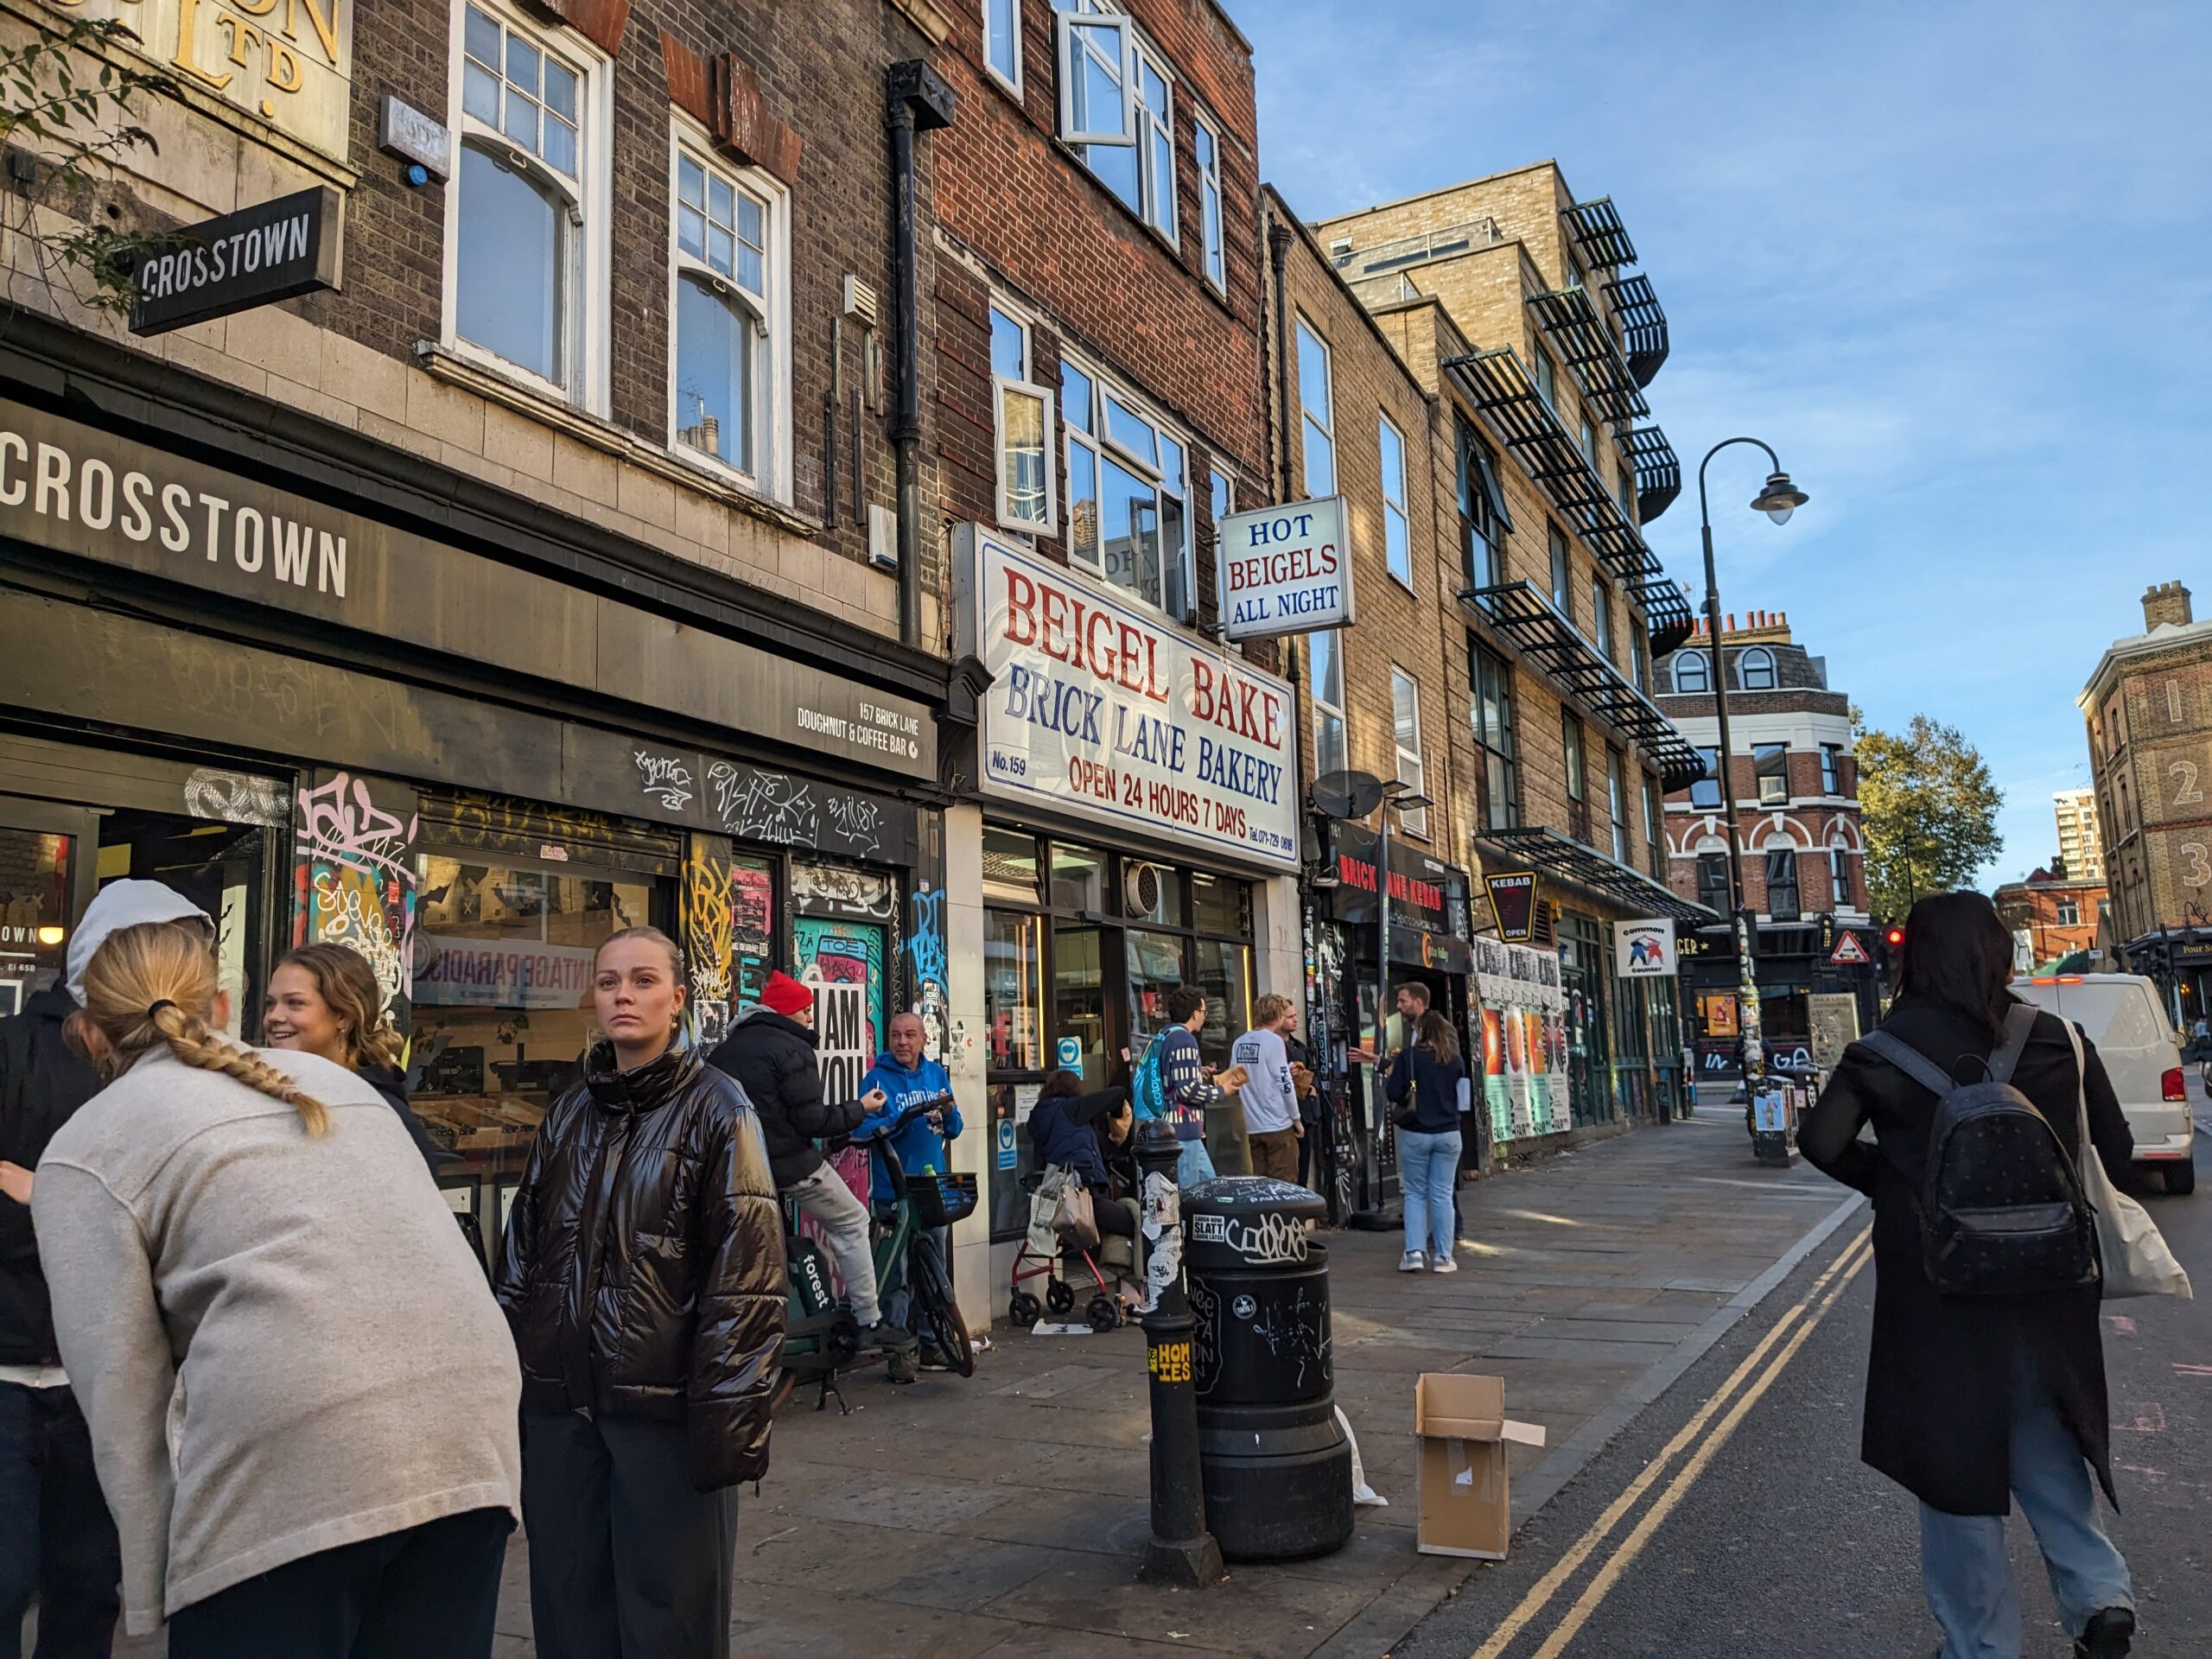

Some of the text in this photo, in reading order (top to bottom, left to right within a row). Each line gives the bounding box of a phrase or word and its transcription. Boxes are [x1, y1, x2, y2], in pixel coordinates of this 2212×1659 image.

[142, 213, 309, 302] CROSSTOWN
[0, 431, 346, 598] CROSSTOWN
[1249, 514, 1313, 547] HOT
[1229, 543, 1338, 591] BEIGELS
[1232, 585, 1338, 625] ALL NIGHT
[1002, 565, 1170, 704] BEIGEL
[1190, 657, 1281, 752] BAKE
[798, 707, 906, 757] DOUGHNUT & COFFEE BAR
[859, 702, 918, 735] 157 BRICK LANE
[1005, 663, 1283, 805] BRICK LANE BAKERY
[1069, 755, 1246, 839] OPEN 24 HOURS 7 DAYS
[2168, 760, 2204, 805] 2
[1330, 823, 1341, 839] 161
[1340, 855, 1441, 912] BRICK ANE KEBAB
[1491, 877, 1531, 888] KEBAB
[2180, 842, 2212, 888] 3
[2183, 945, 2202, 954] Four
[824, 988, 860, 1051] AM
[1150, 1058, 1162, 1105] cotopaxi
[1194, 1222, 1223, 1235] SLATT
[804, 1253, 830, 1310] forest
[1159, 1342, 1190, 1363] HOM
[1159, 1362, 1191, 1382] IES
